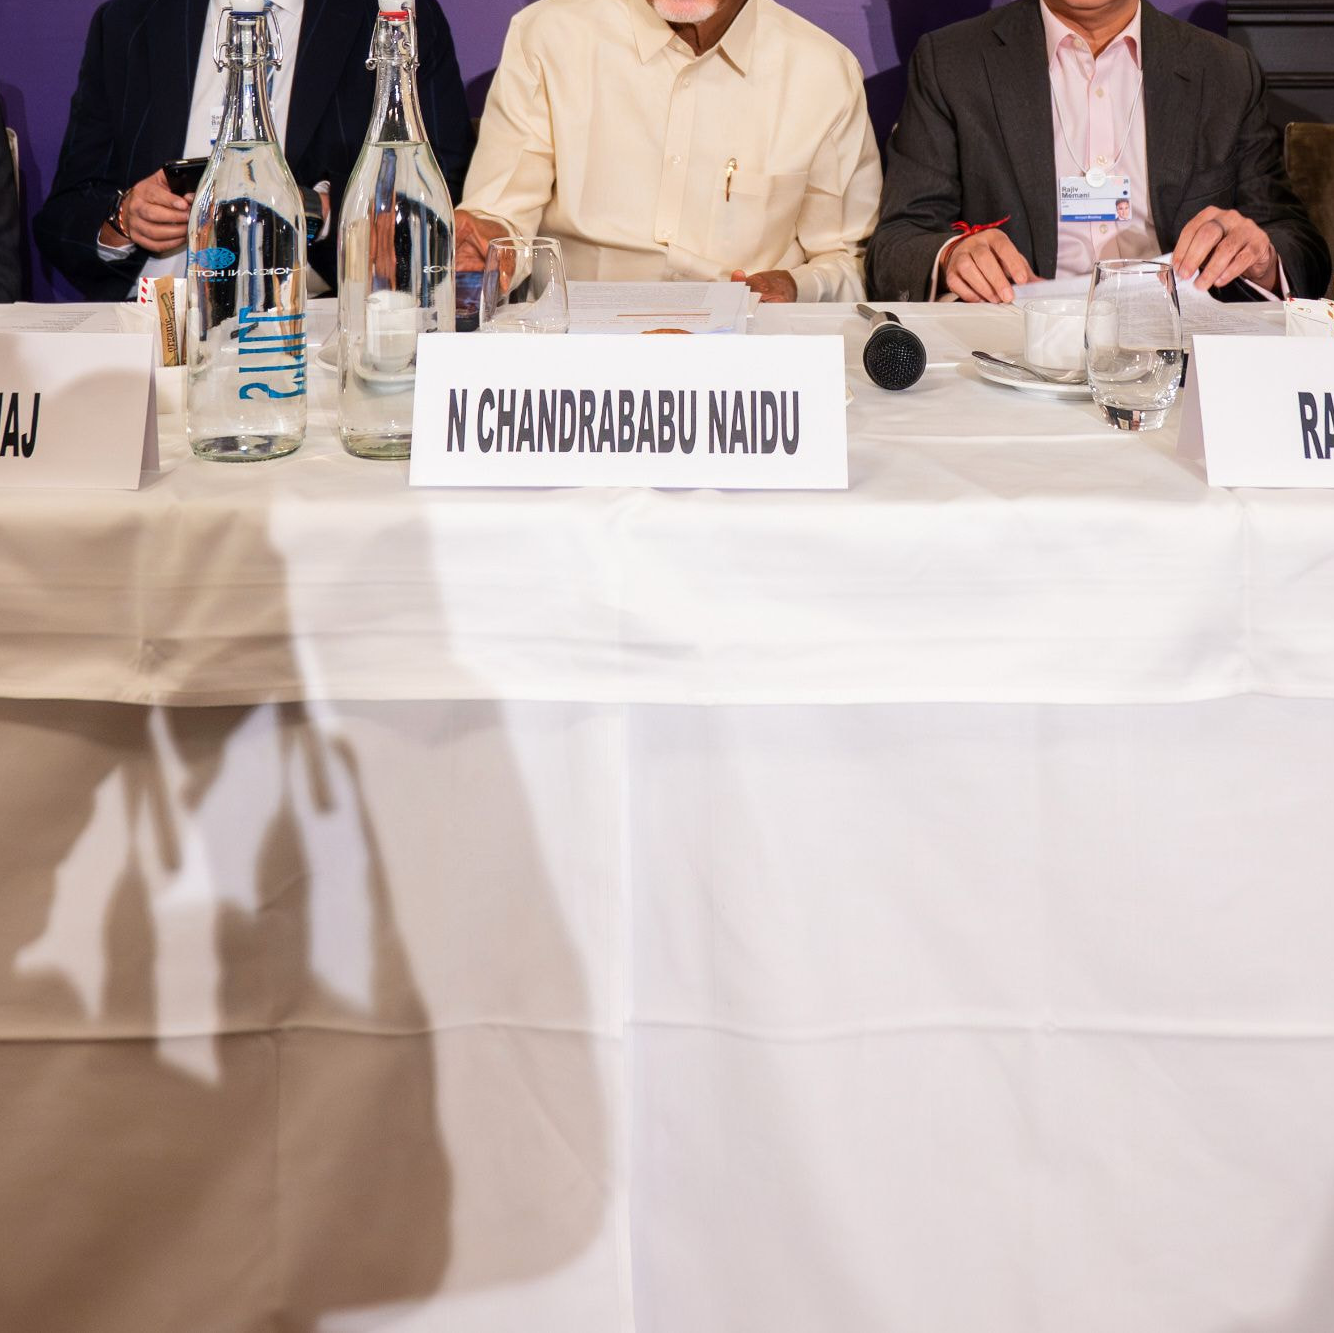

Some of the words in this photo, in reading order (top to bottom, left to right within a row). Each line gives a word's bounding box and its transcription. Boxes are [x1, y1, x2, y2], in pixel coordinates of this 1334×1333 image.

[446, 388, 468, 453] N
[476, 387, 697, 455] CHANDRABABU
[708, 390, 800, 455] NAIDU
